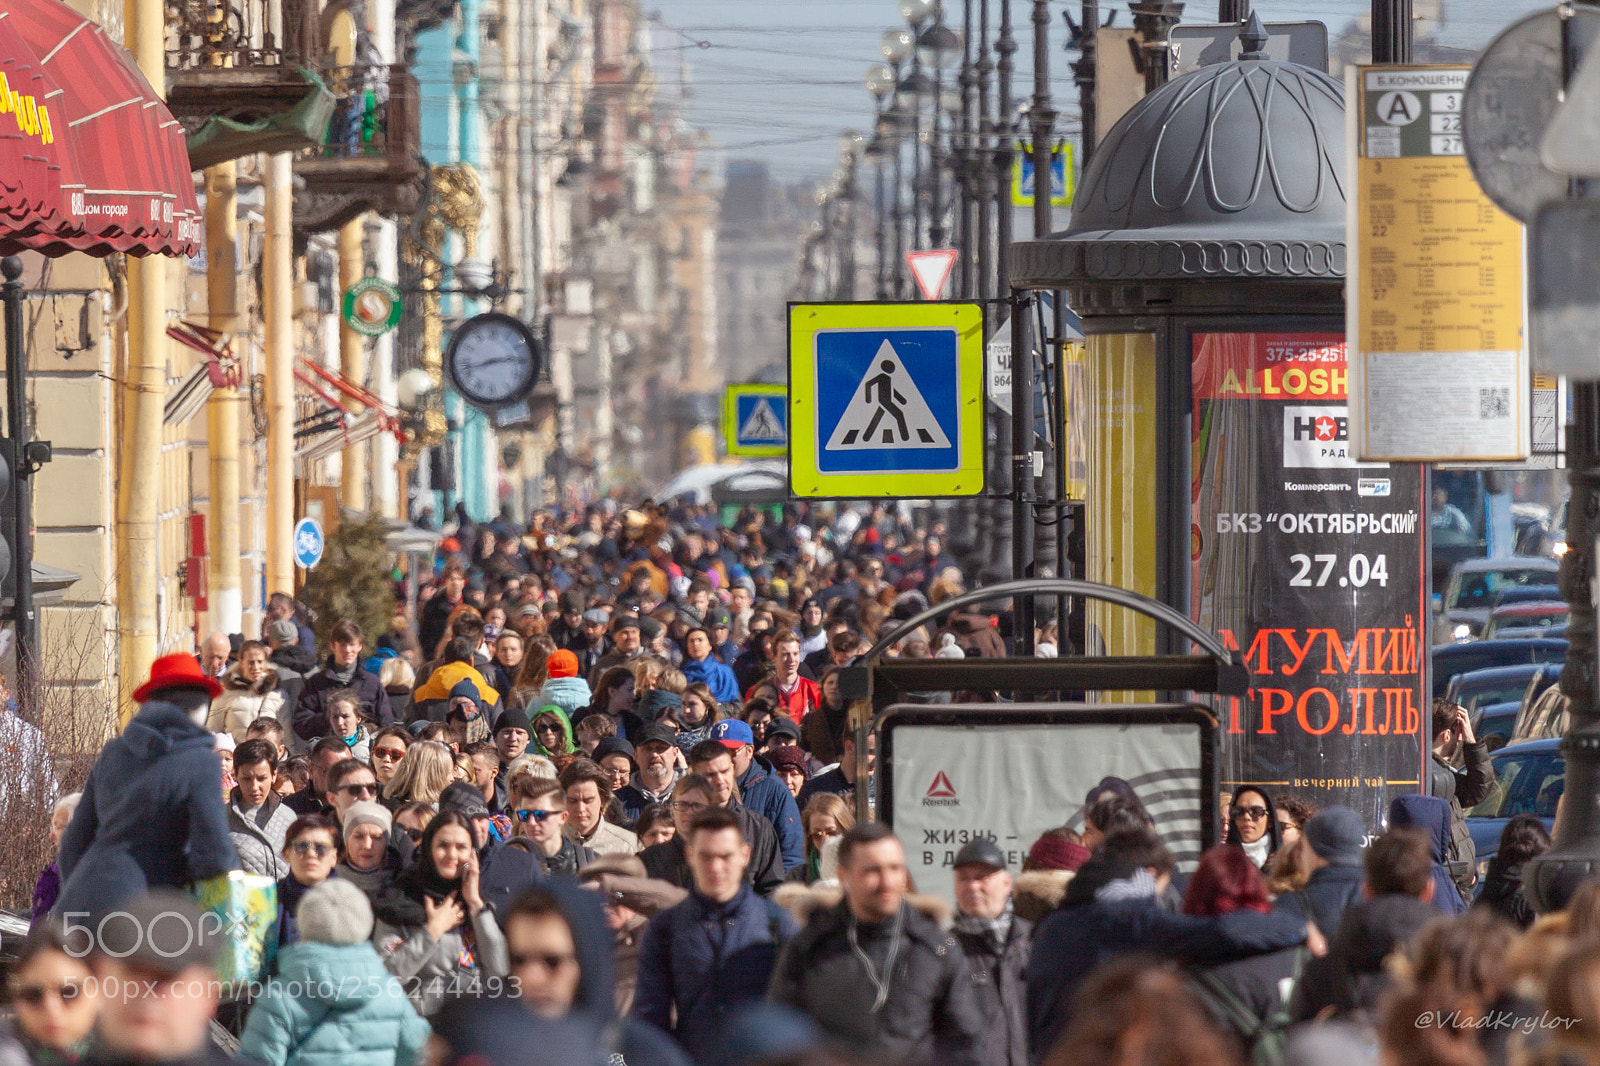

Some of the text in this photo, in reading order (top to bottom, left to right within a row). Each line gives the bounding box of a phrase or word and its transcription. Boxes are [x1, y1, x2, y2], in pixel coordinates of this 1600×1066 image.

[1446, 95, 1457, 110] 3
[1441, 117, 1462, 131] 22
[1442, 138, 1462, 152] 27
[102, 204, 128, 218] городе
[1265, 347, 1339, 362] 375-25-25
[1219, 368, 1348, 395] ALLOSH
[1321, 448, 1349, 458] РАД
[1284, 482, 1352, 492] Коммерсантъ
[1216, 513, 1262, 534] БКЗ
[1289, 553, 1389, 588] 27.04
[1217, 614, 1419, 676] МУМИЙ
[717, 723, 729, 738] P
[1294, 776, 1384, 791] вечерний чай
[922, 797, 961, 807] Reebok
[923, 851, 934, 865] В
